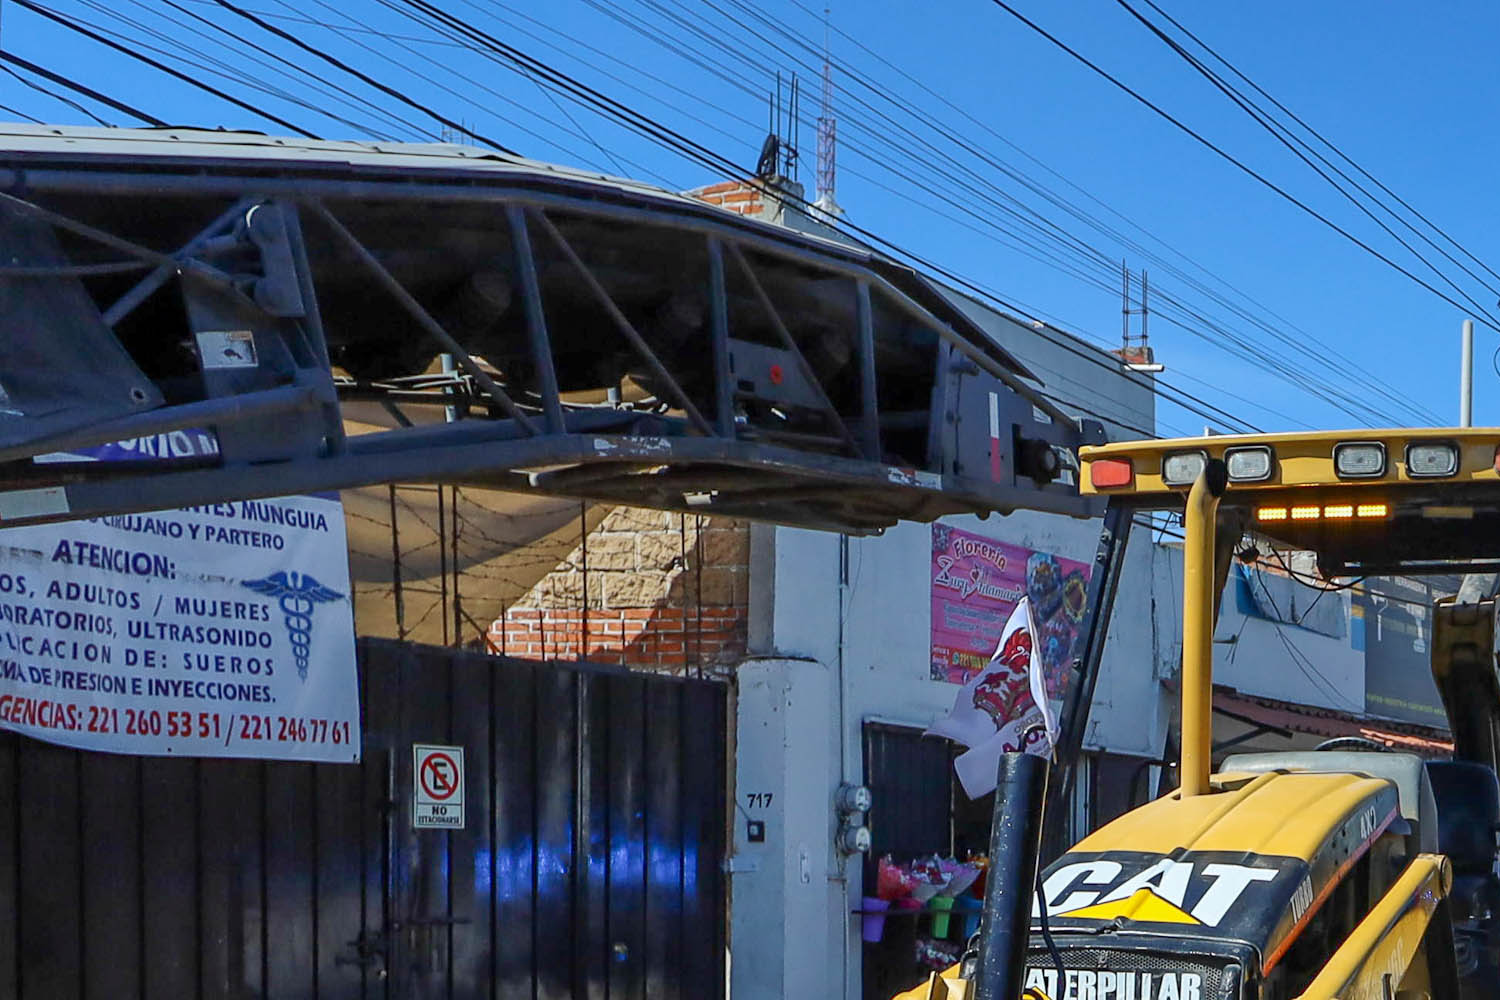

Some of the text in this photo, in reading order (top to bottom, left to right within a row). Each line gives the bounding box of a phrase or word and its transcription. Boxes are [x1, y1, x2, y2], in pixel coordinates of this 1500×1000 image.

[241, 500, 329, 532] MUNGUIA
[189, 523, 200, 541] Y
[206, 525, 285, 551] PARTERO
[52, 538, 176, 580] ATENCION:
[47, 580, 140, 610] ADULTOS
[153, 594, 163, 617] /
[175, 597, 270, 622] MUJERES
[128, 620, 272, 648] ULTRASONIDO
[0, 632, 274, 676] LICACION DE: SUEROS
[29, 666, 52, 686] DE
[55, 669, 126, 695] PRESION
[132, 678, 142, 695] E
[148, 679, 276, 703] INYECCIONES.
[88, 705, 118, 733] 221
[126, 709, 161, 735] 260
[168, 711, 192, 737] 53
[198, 712, 220, 738] 51
[225, 714, 234, 747] /
[240, 714, 272, 741] 221
[278, 716, 307, 743] 246
[311, 719, 328, 743] 77
[332, 720, 349, 745] 61
[432, 806, 448, 815] NO
[747, 793, 773, 809] 717
[1032, 861, 1279, 927] CAT
